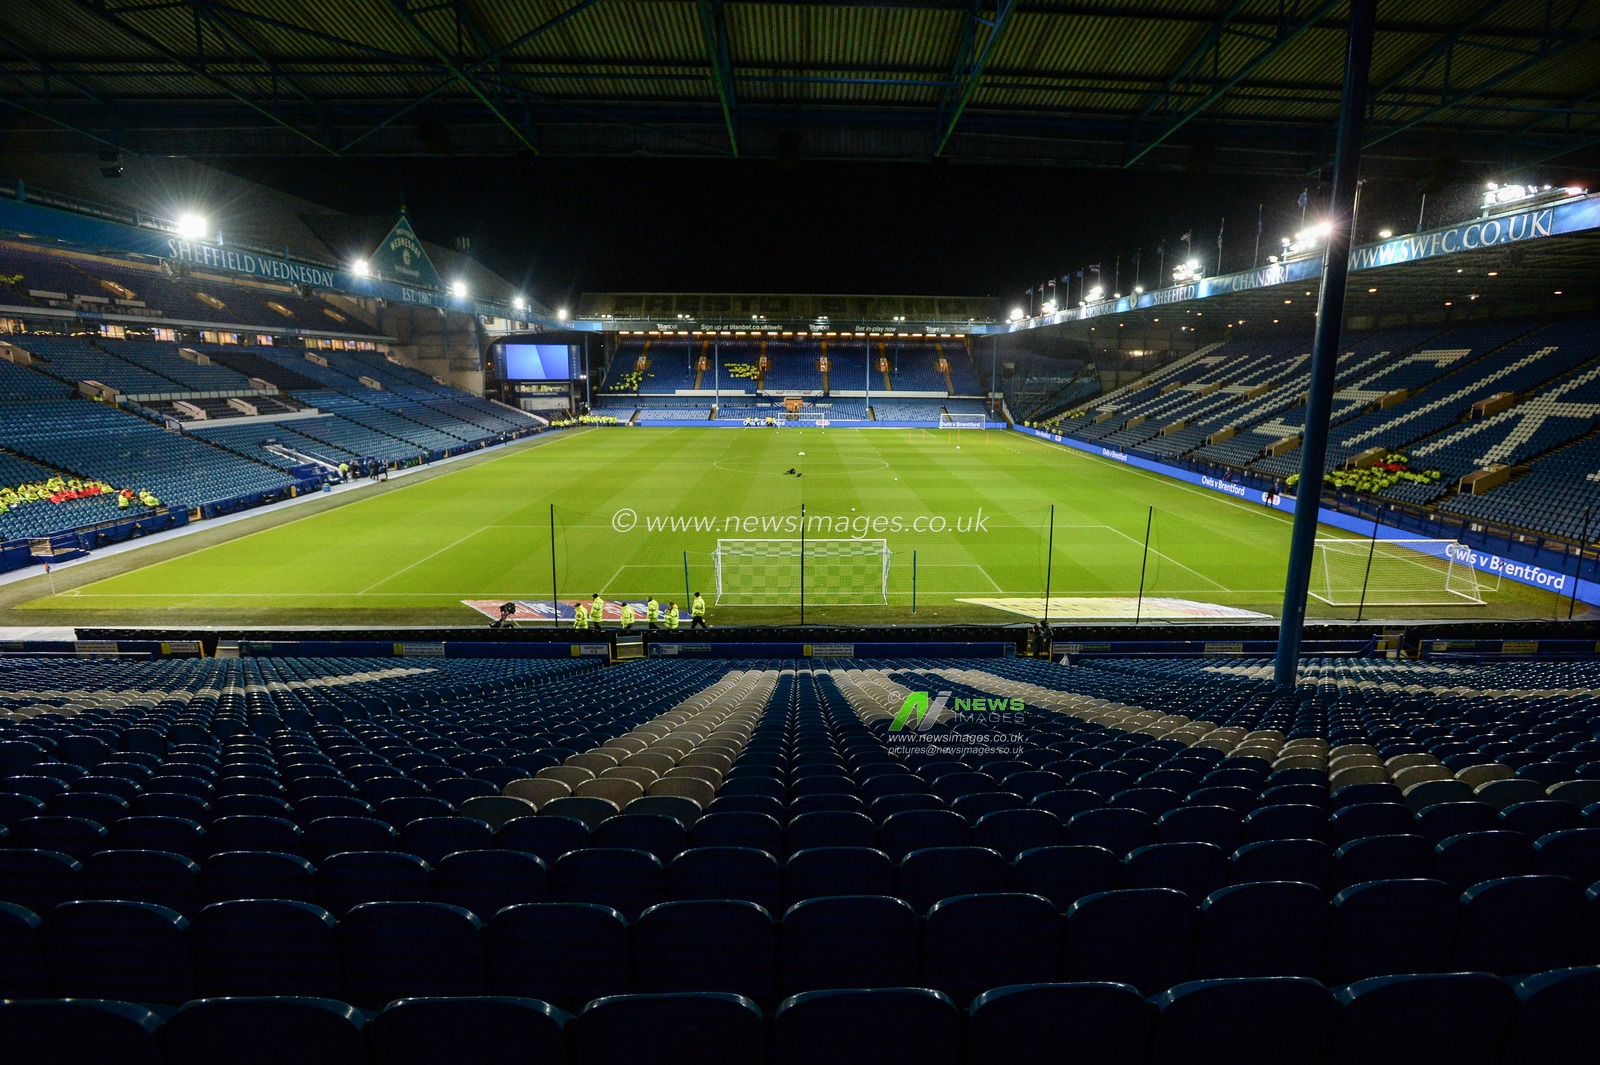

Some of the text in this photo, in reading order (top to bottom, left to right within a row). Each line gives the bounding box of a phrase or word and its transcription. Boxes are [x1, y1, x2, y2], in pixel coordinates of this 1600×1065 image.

[389, 237, 421, 258] WEDNESDAY
[1346, 208, 1552, 271] WWW.SWFC.CO.UK
[167, 238, 335, 288] SHEFFIELD WEDNESDAY
[1231, 264, 1291, 291] CHANSRI
[1153, 284, 1196, 306] SHEFFIELD
[855, 324, 866, 332] Bet
[866, 325, 884, 333] in-play
[1201, 475, 1215, 488] Owls
[1218, 479, 1246, 496] Brentford
[1444, 543, 1567, 590] Owls v Brentford
